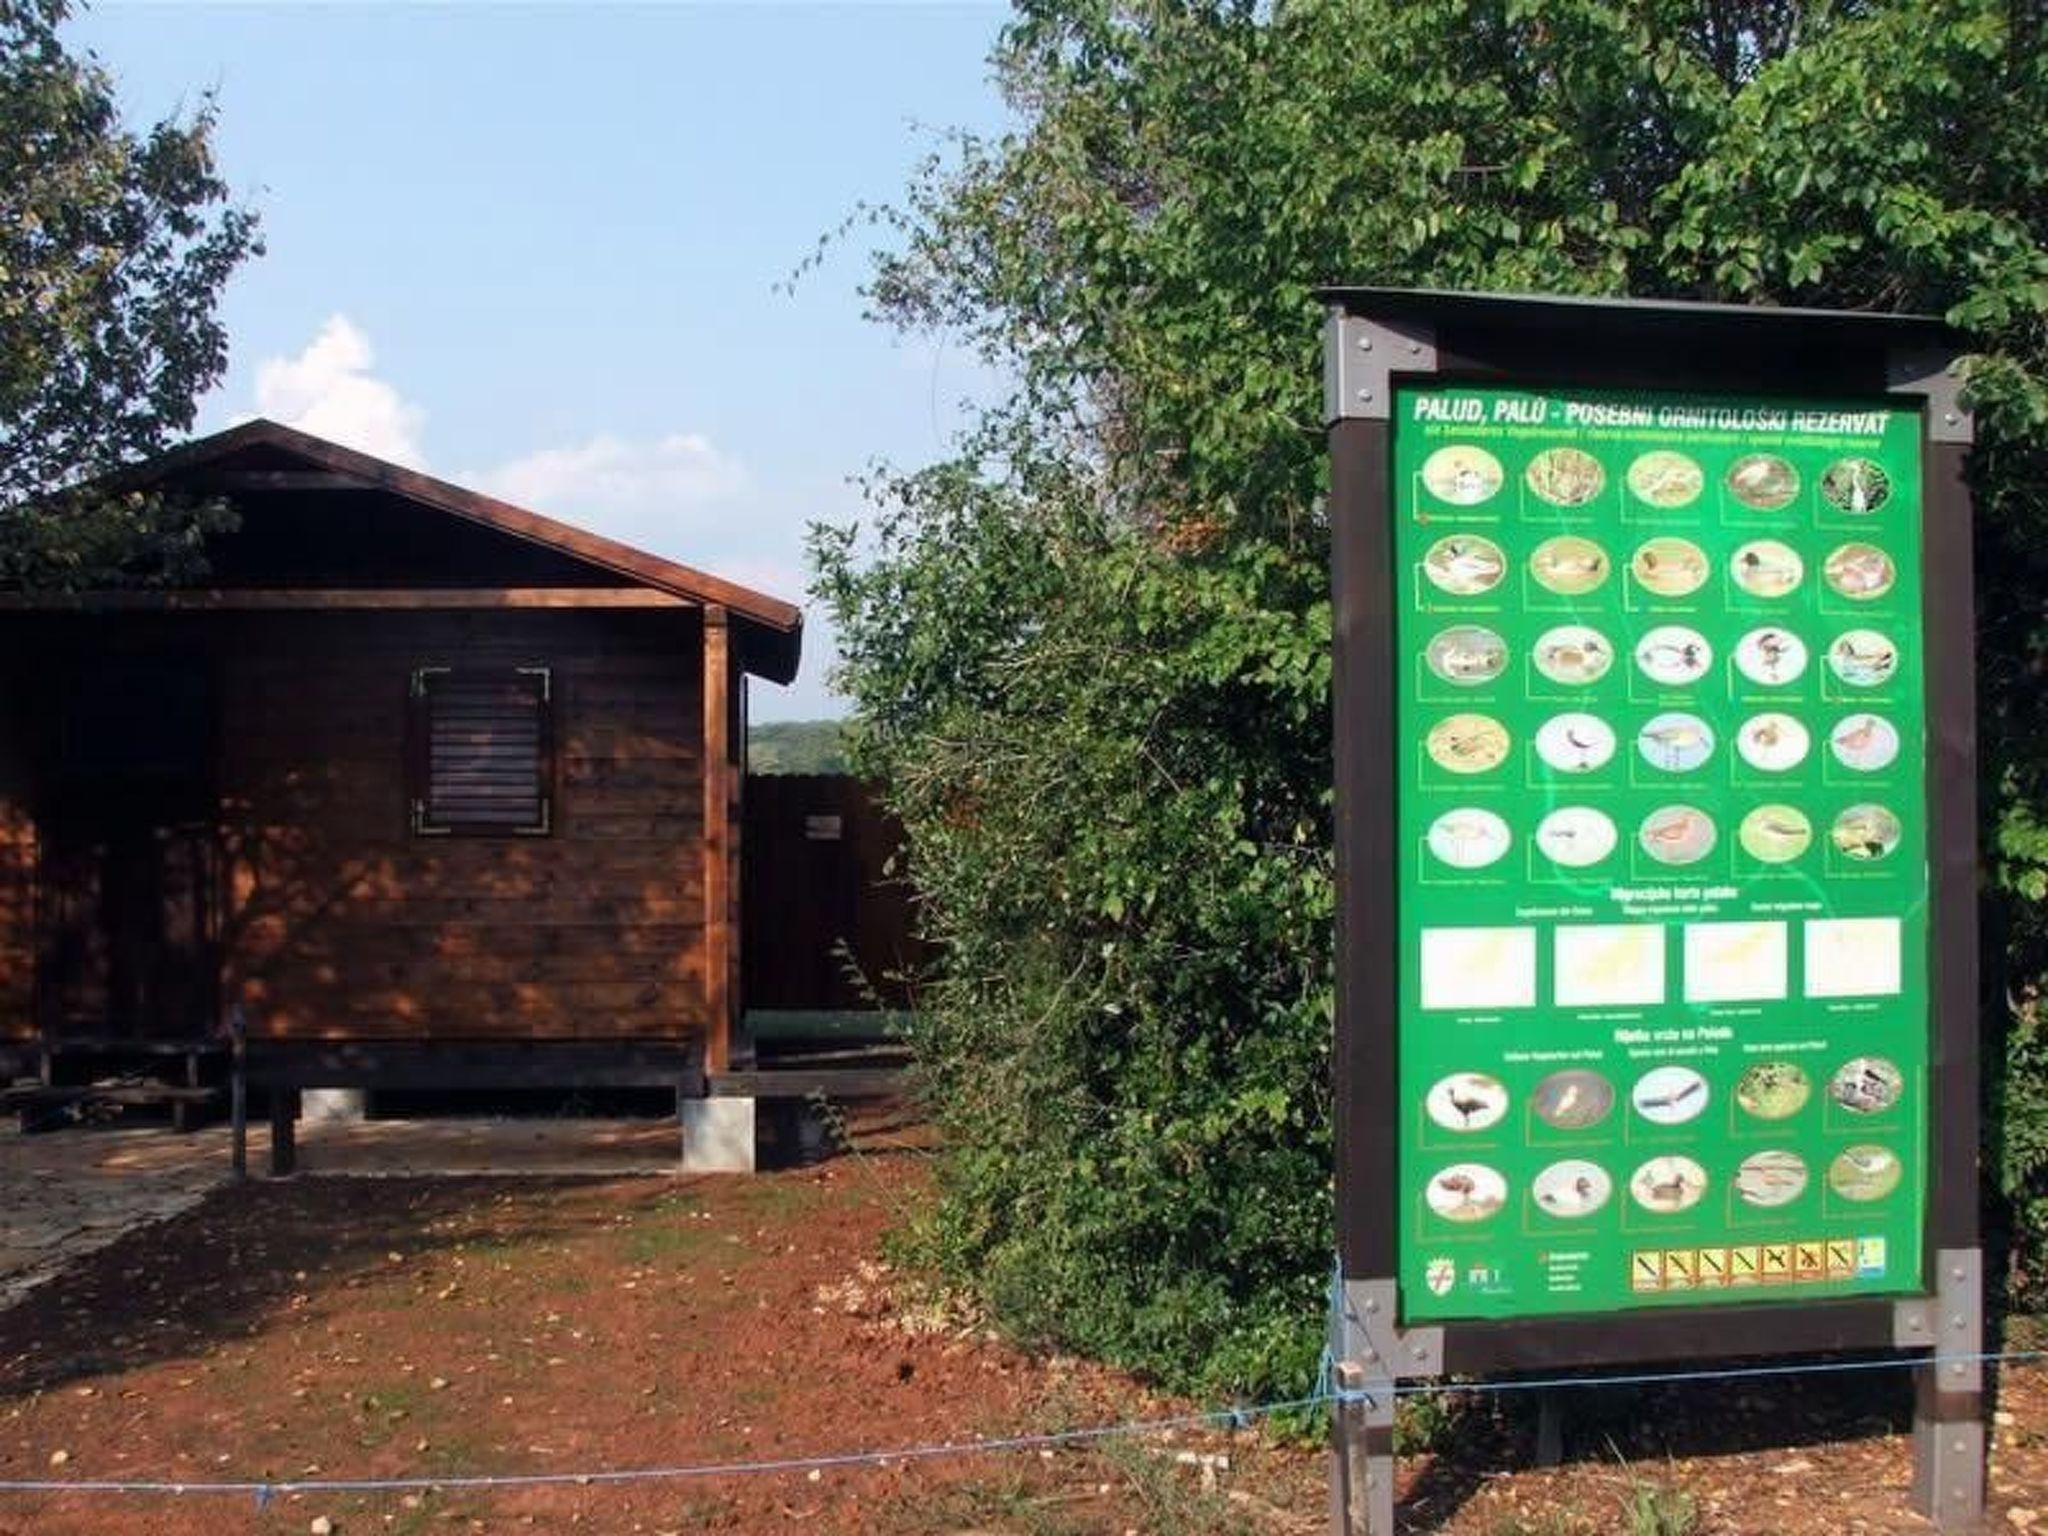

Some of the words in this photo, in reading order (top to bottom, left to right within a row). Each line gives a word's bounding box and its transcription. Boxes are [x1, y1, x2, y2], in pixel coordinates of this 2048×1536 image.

[1413, 397, 1487, 424] PALUD,
[1564, 402, 1653, 425] POSEBNI
[1790, 410, 1891, 435] REZERVAT
